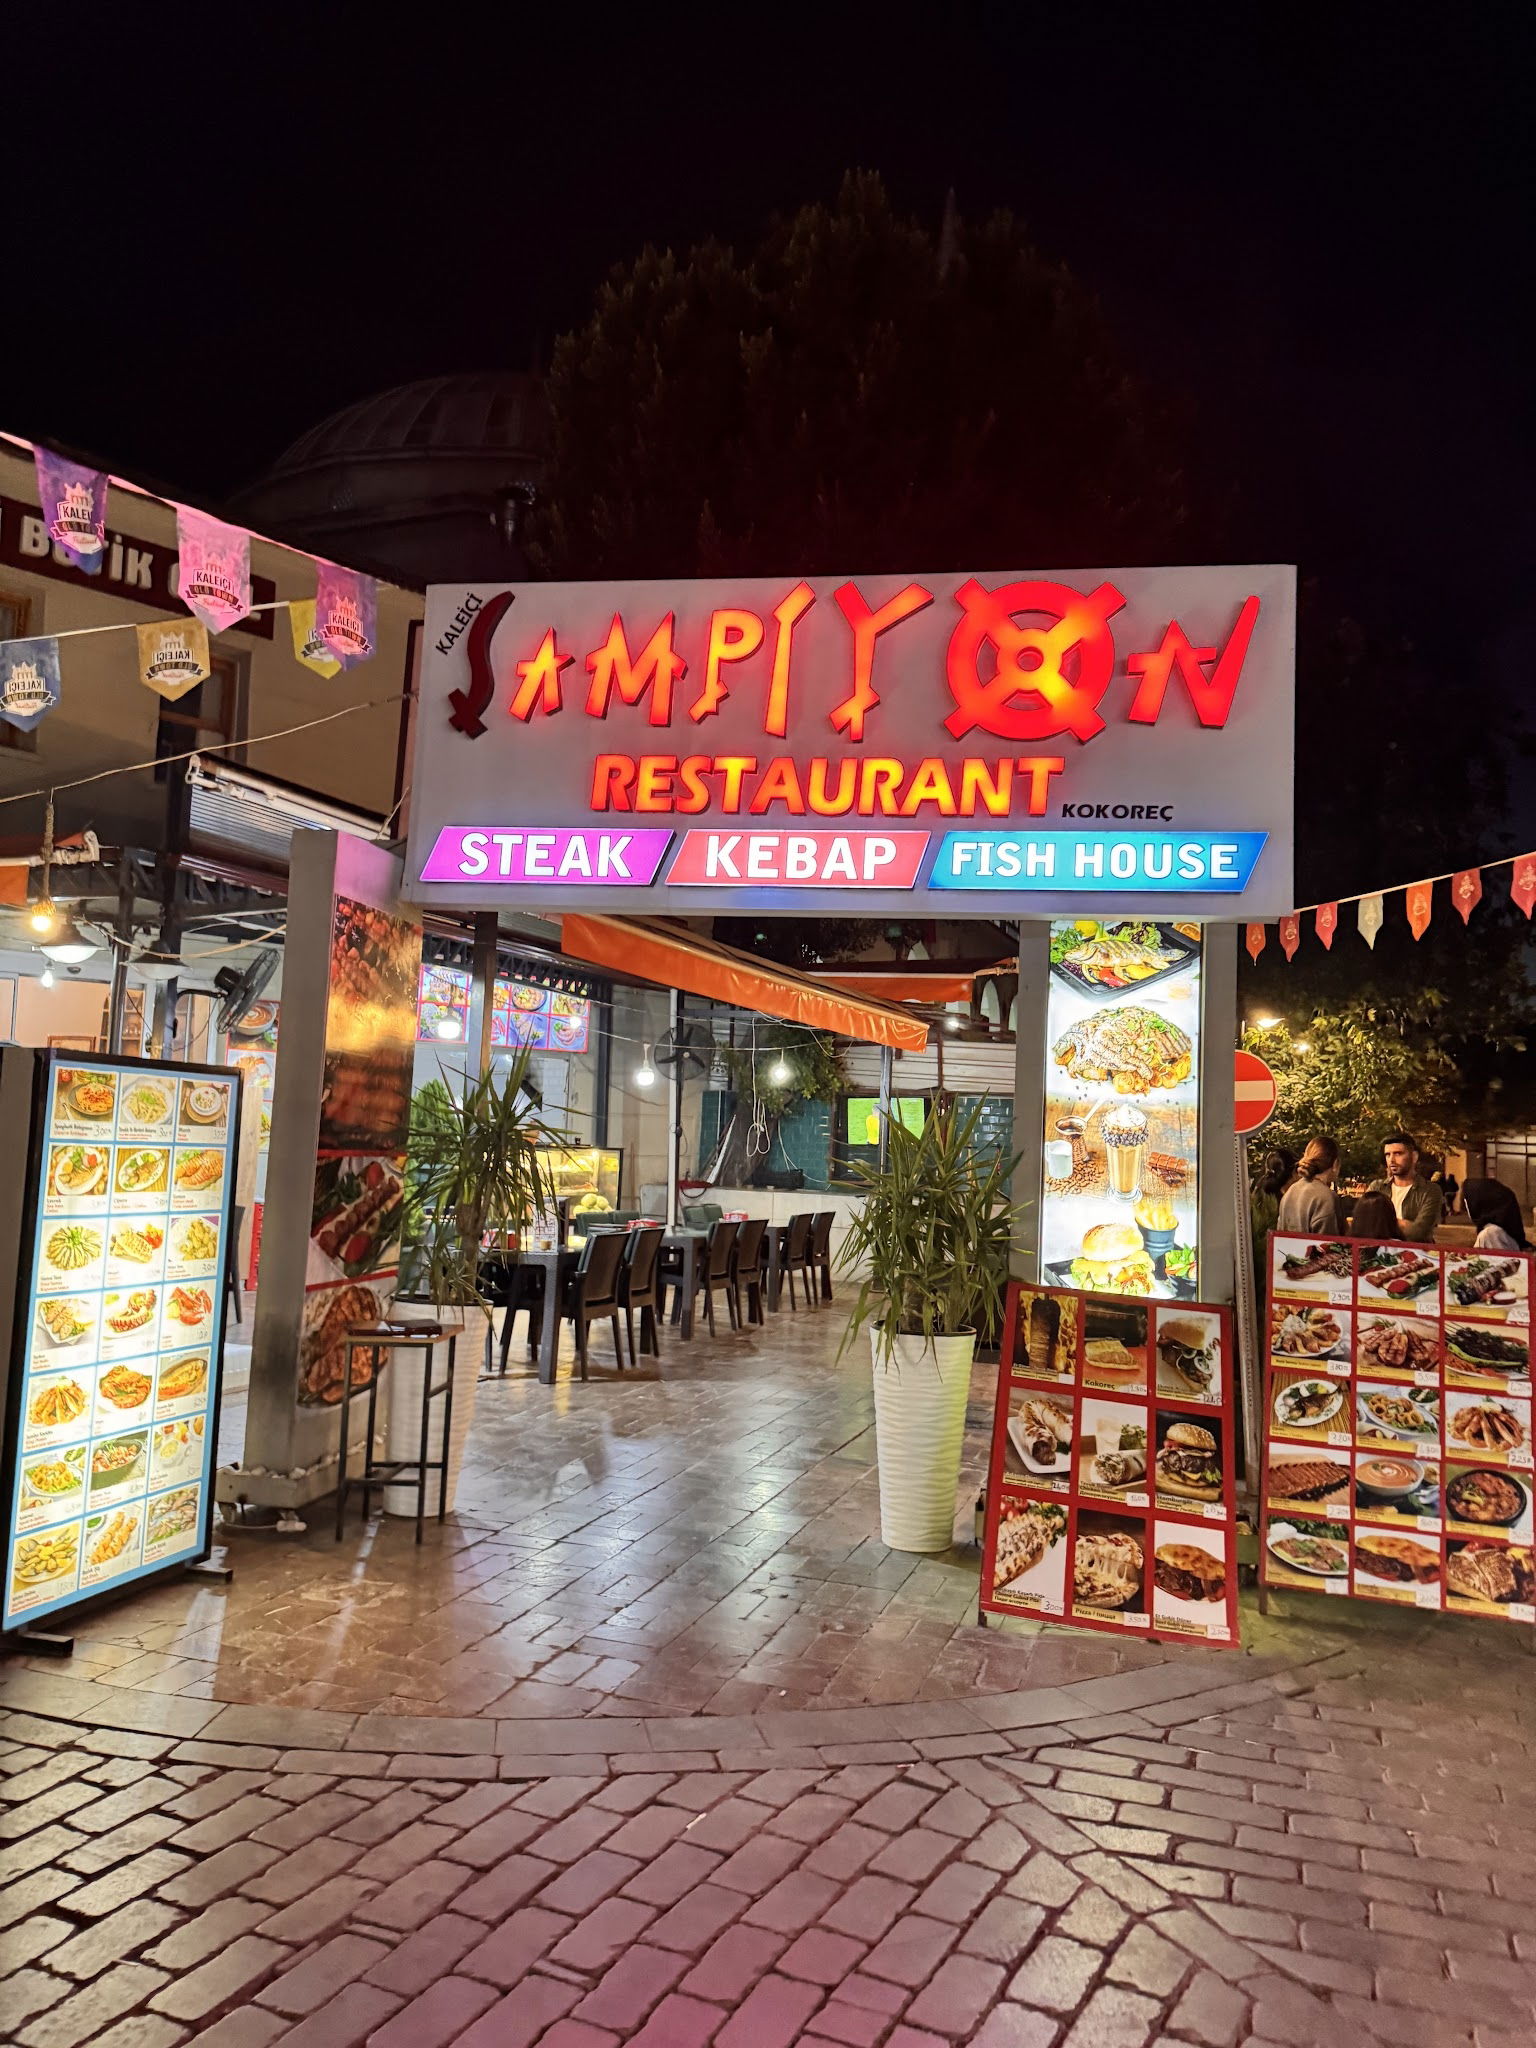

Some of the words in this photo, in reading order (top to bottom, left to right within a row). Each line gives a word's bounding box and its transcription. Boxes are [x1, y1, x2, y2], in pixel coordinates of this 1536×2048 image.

[434, 591, 484, 656] KALEİÇİ
[590, 753, 1066, 816] RESTAURANT
[1061, 803, 1175, 822] KOKOREÇ
[458, 831, 634, 878] STEAK
[704, 834, 897, 880] KEBAP
[951, 841, 1056, 879] FISH
[1074, 842, 1240, 880] HOUSE
[1075, 1607, 1092, 1616] Pizza
